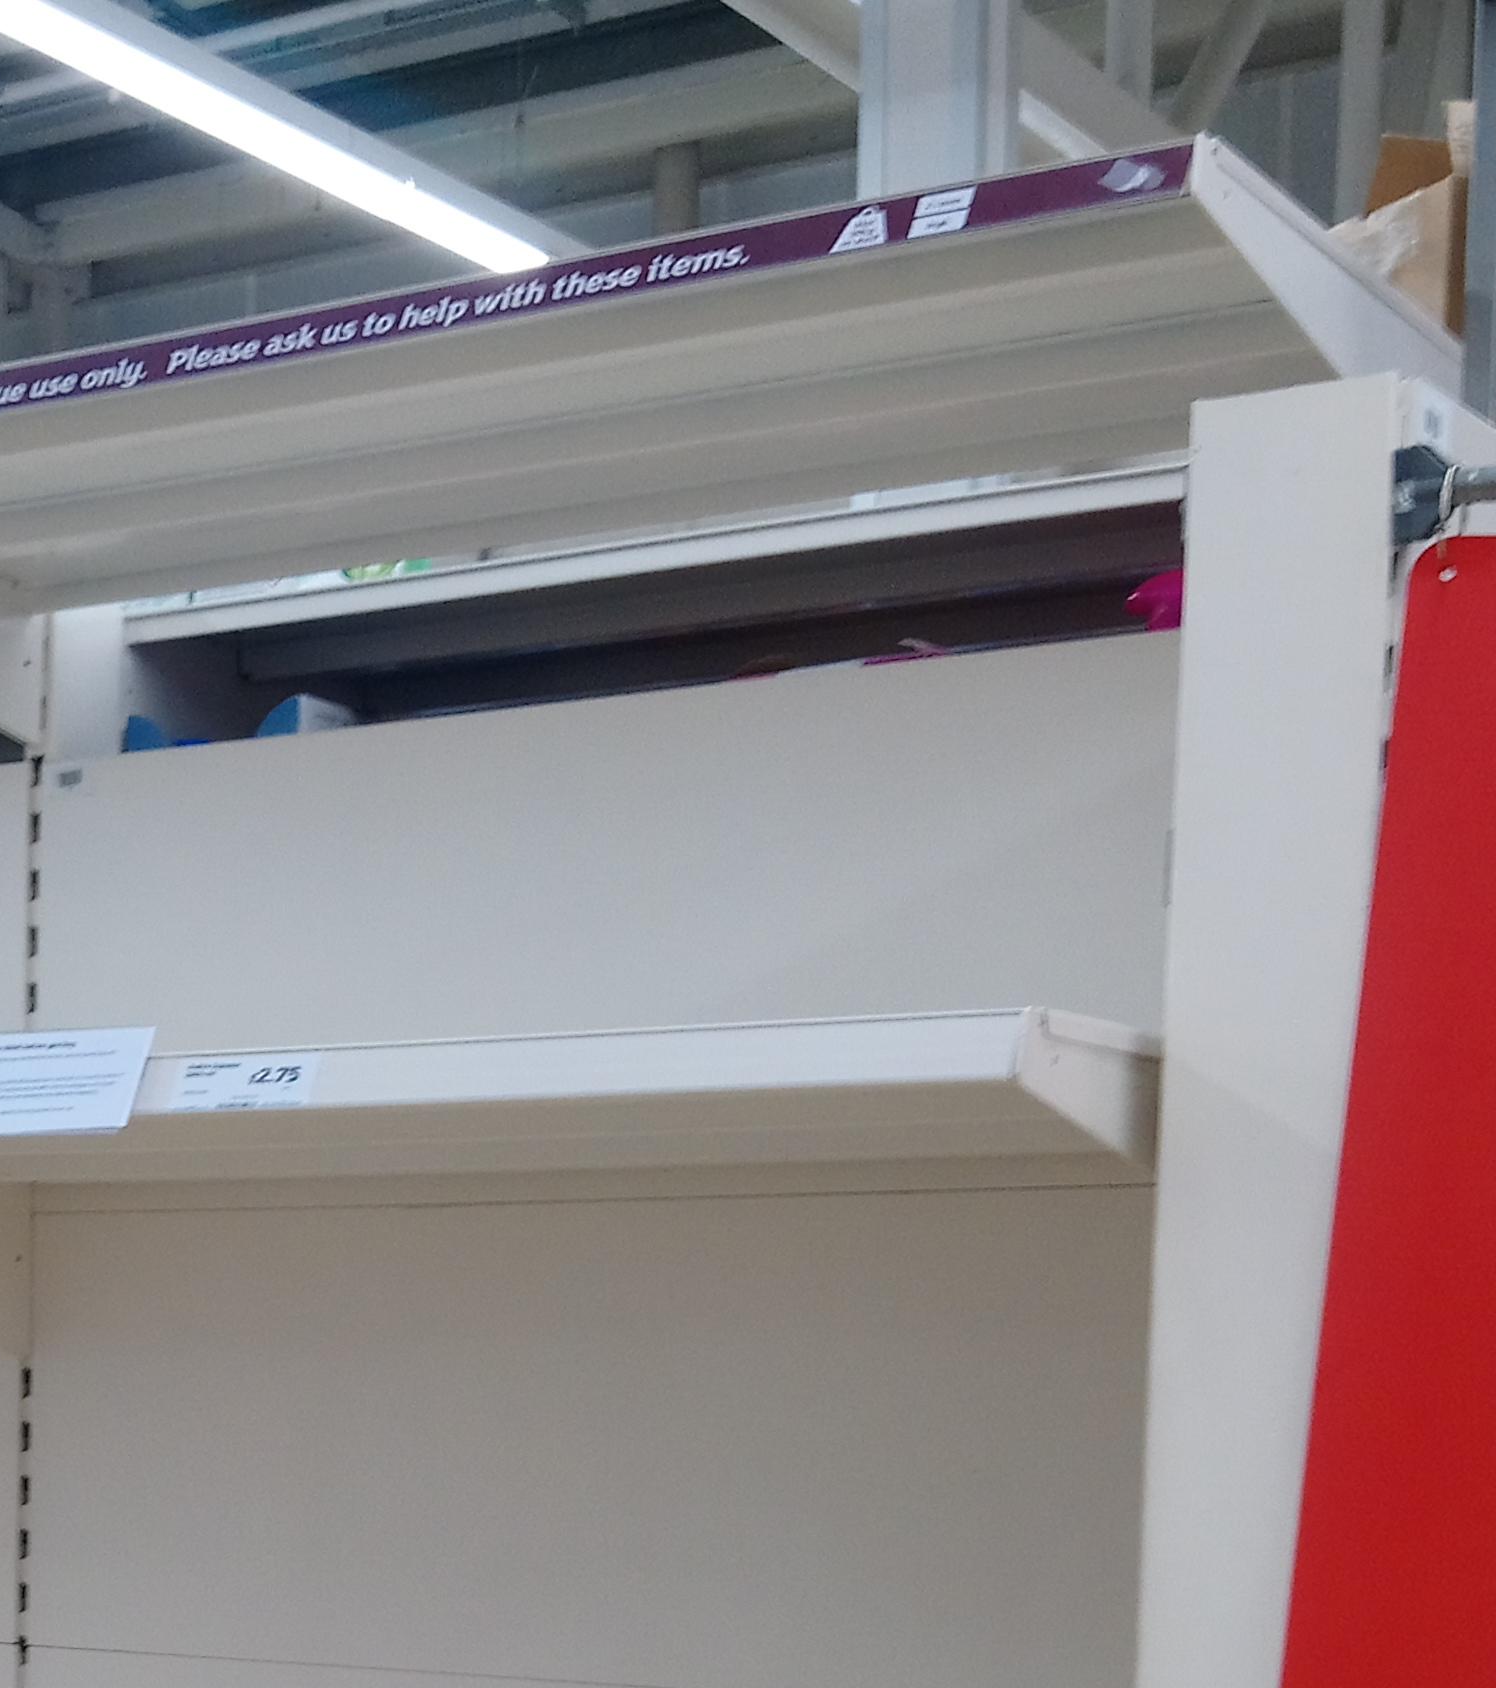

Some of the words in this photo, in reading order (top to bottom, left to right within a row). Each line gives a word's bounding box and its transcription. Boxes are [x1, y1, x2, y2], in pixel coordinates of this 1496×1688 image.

[29, 372, 77, 400] use
[80, 358, 146, 392] only.
[166, 338, 258, 376] Please
[262, 326, 315, 358] ask
[320, 318, 357, 347] us
[361, 310, 395, 337] to
[397, 295, 468, 334] help
[472, 279, 545, 316] with
[550, 265, 642, 302] these
[646, 242, 750, 286] items.
[248, 1065, 301, 1085] £2.75
